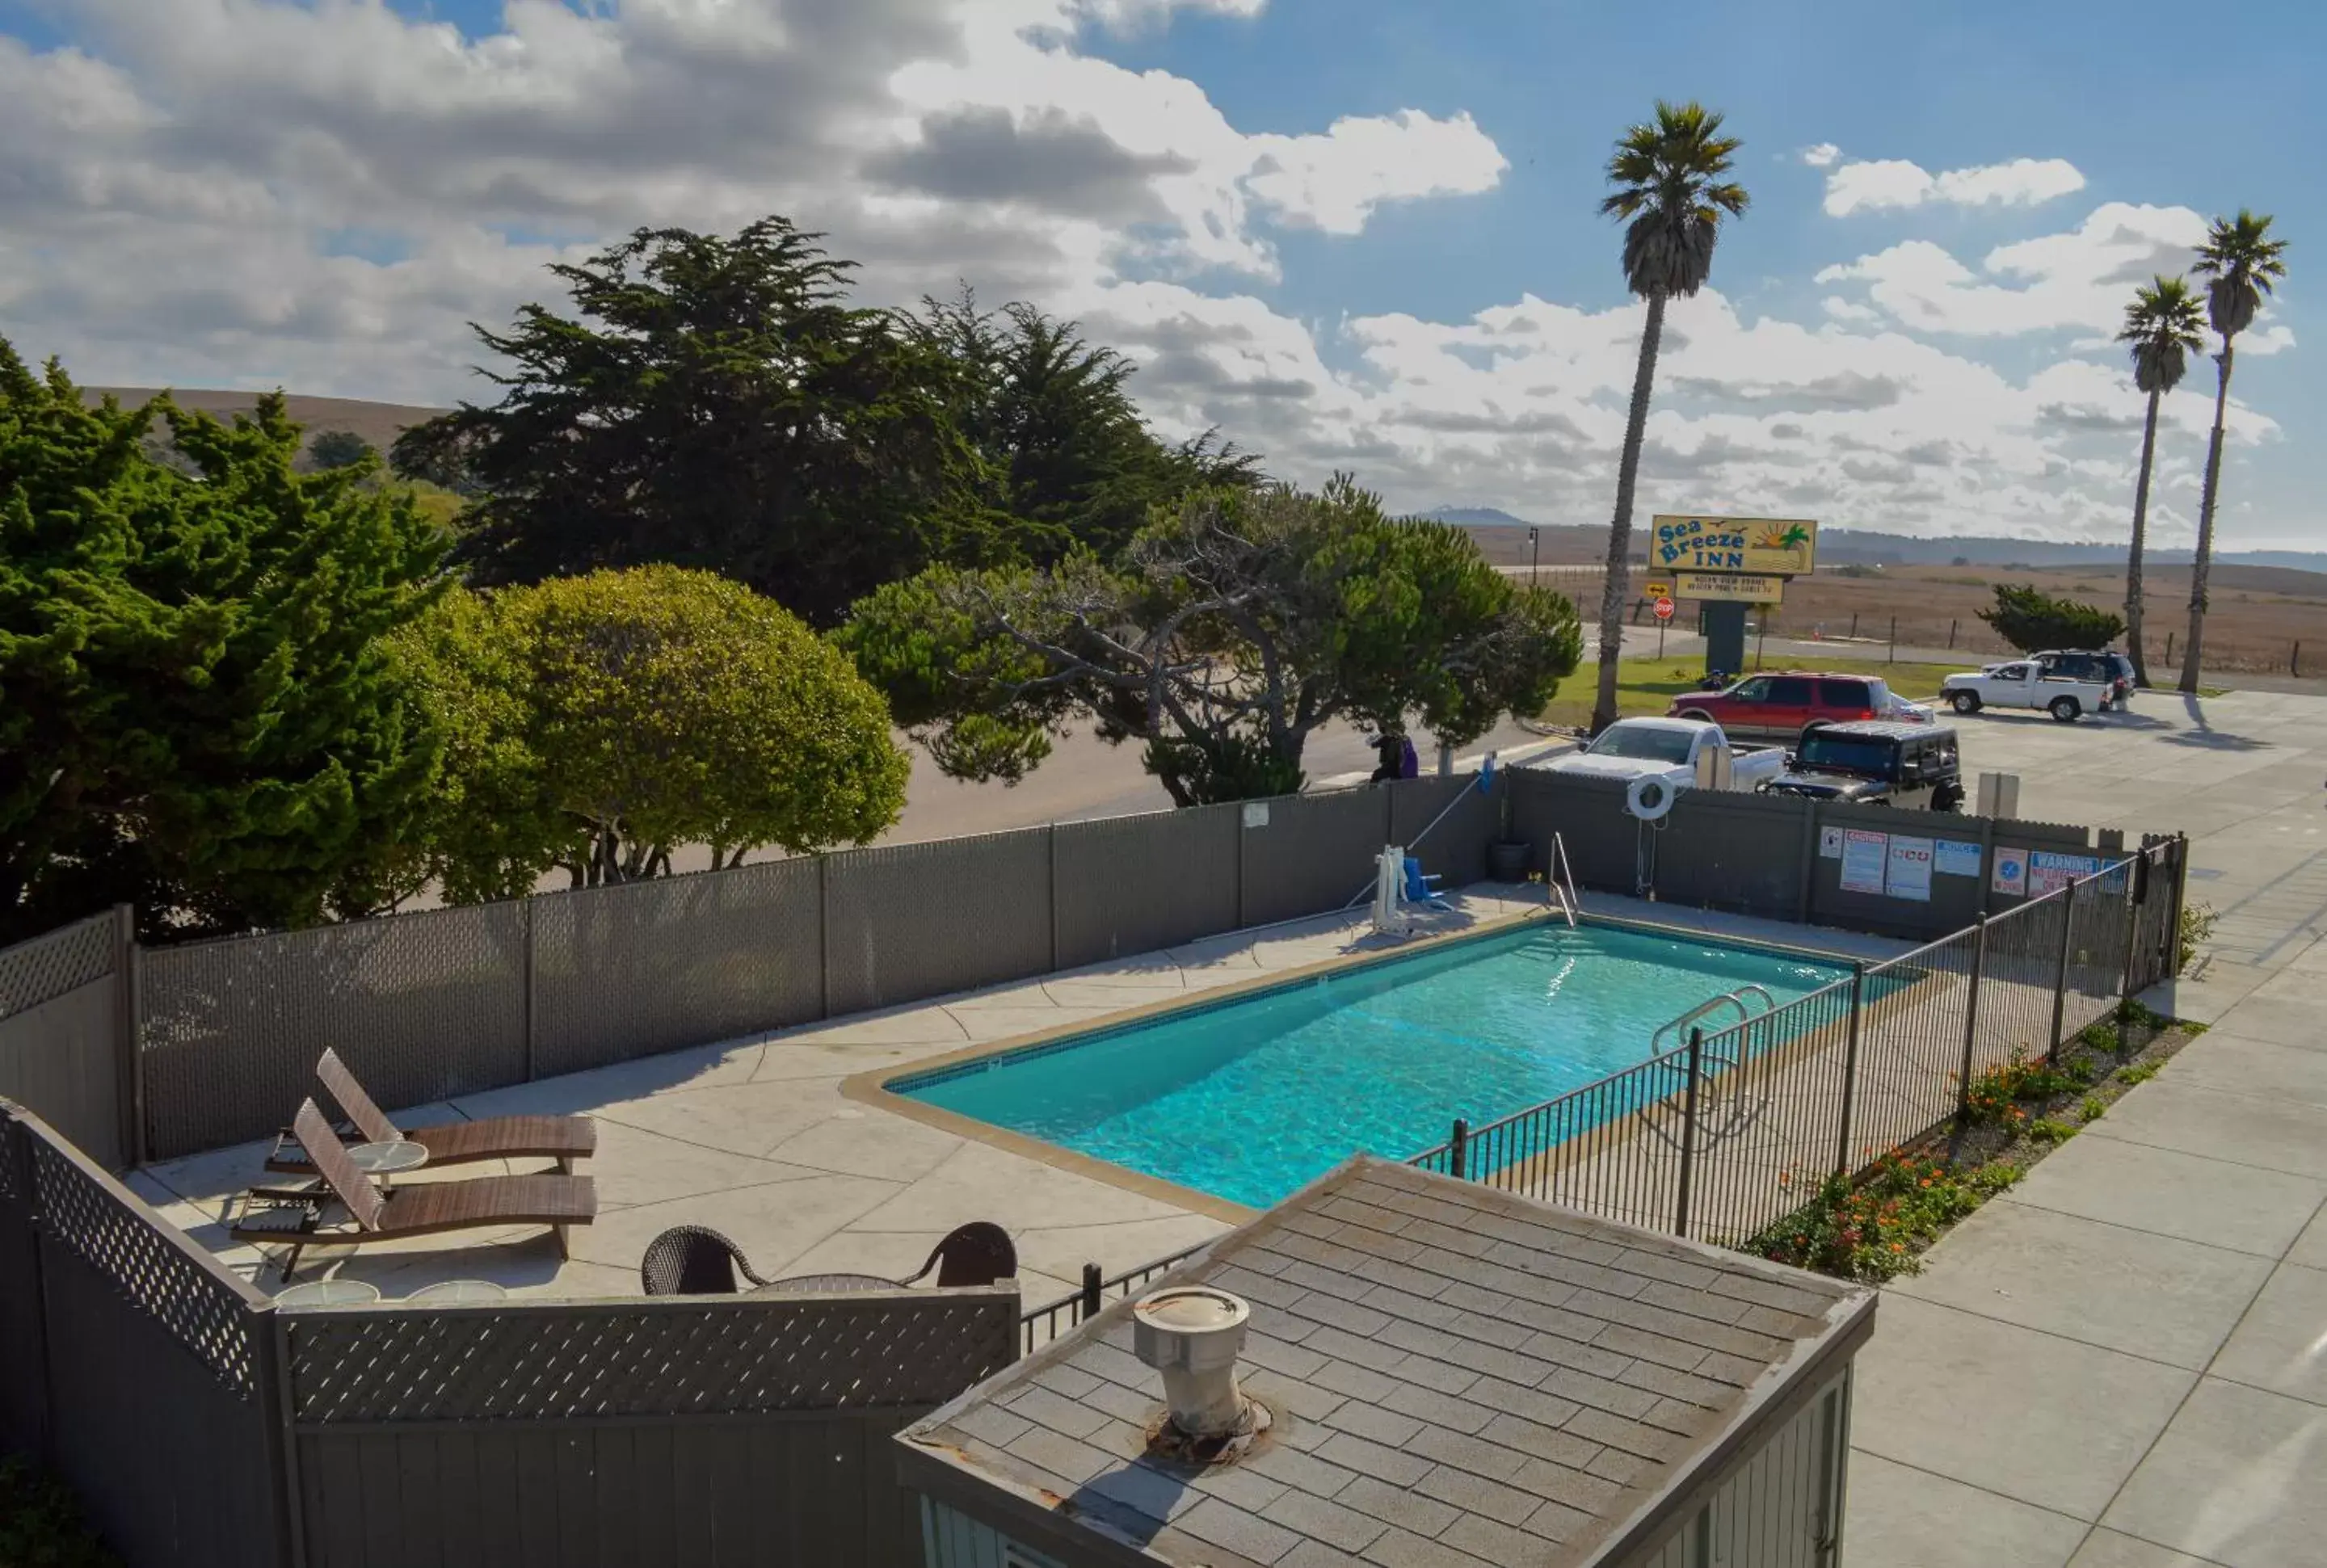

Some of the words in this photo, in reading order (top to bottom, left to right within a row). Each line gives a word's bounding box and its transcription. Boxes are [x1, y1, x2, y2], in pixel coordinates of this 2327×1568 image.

[1659, 520, 1701, 543] Sea
[1660, 534, 1745, 563] Breeze
[1695, 552, 1743, 567] INN
[1656, 604, 1673, 612] STOP
[1849, 831, 1887, 843] CAUTION
[2038, 854, 2093, 872] WARNING
